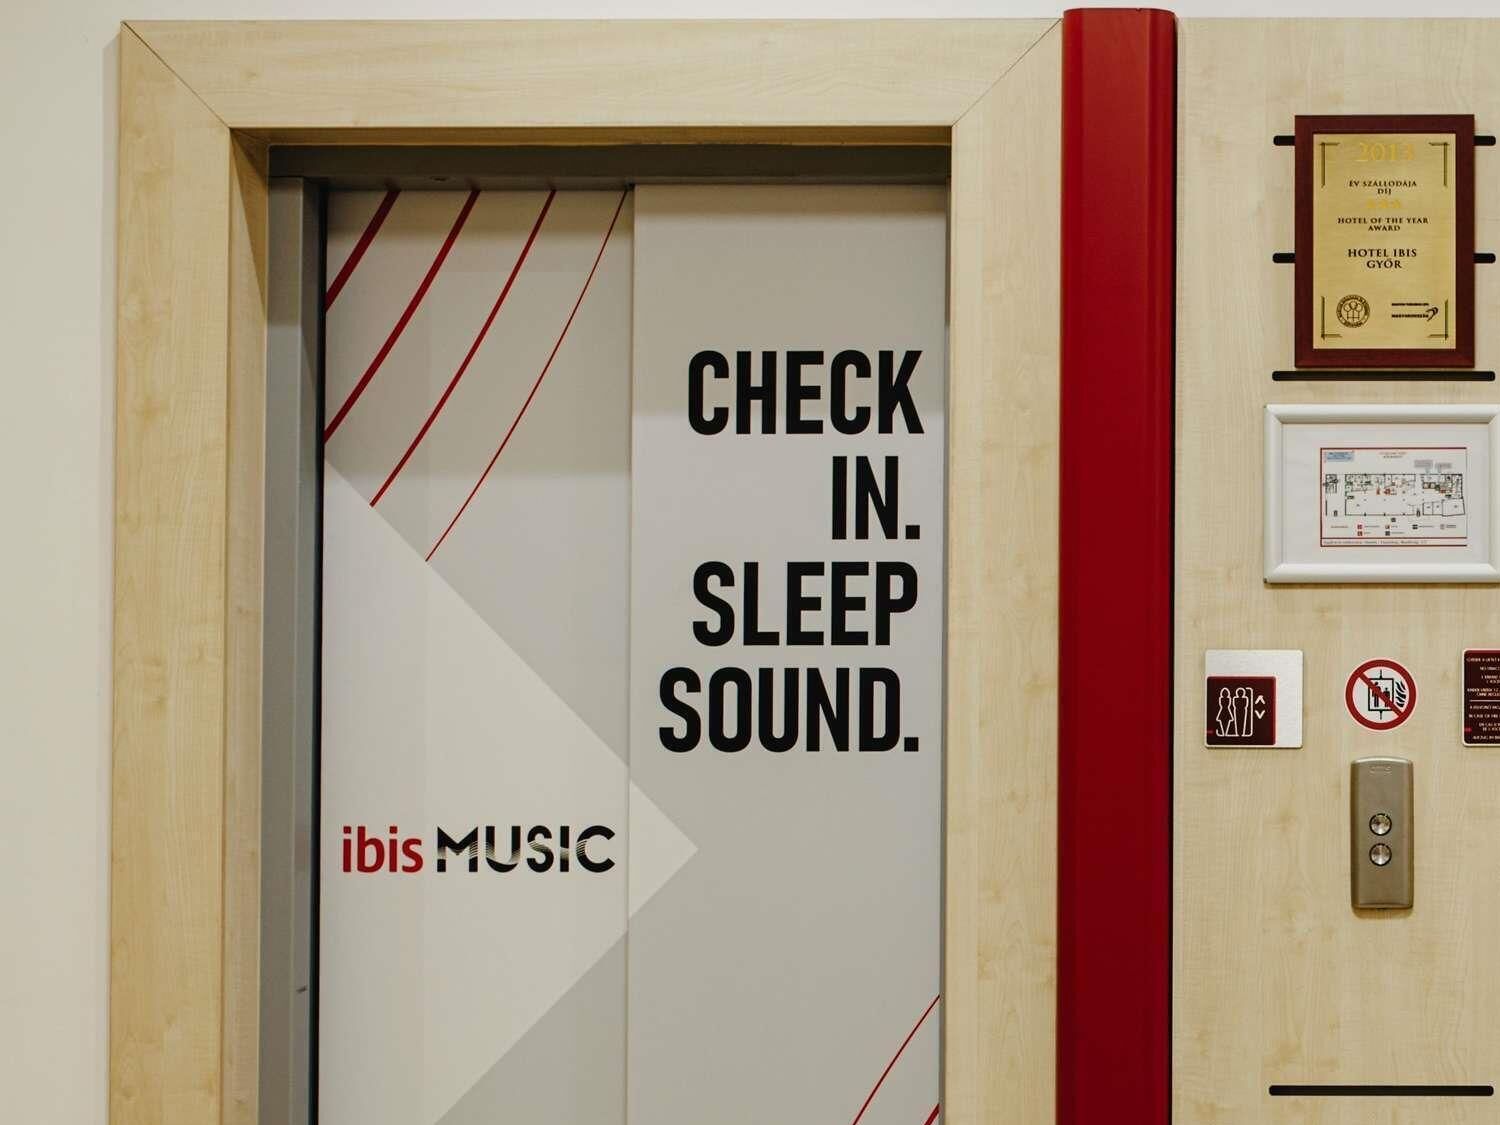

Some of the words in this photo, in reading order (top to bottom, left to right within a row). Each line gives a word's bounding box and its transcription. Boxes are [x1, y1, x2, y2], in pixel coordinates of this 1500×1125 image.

[1337, 216, 1367, 225] HOTEL
[1370, 216, 1382, 225] OF
[1385, 216, 1404, 225] THE
[1406, 216, 1429, 225] YEAR
[1347, 248, 1389, 258] HOTEL
[1393, 248, 1418, 258] IBIS
[1368, 224, 1401, 232] AWARD
[689, 350, 925, 435] CHECK
[831, 455, 921, 540] IN.
[692, 560, 918, 647] SLEEP
[658, 666, 919, 753] SOUND.
[342, 825, 424, 873] ibis
[436, 825, 616, 873] MUSIC
